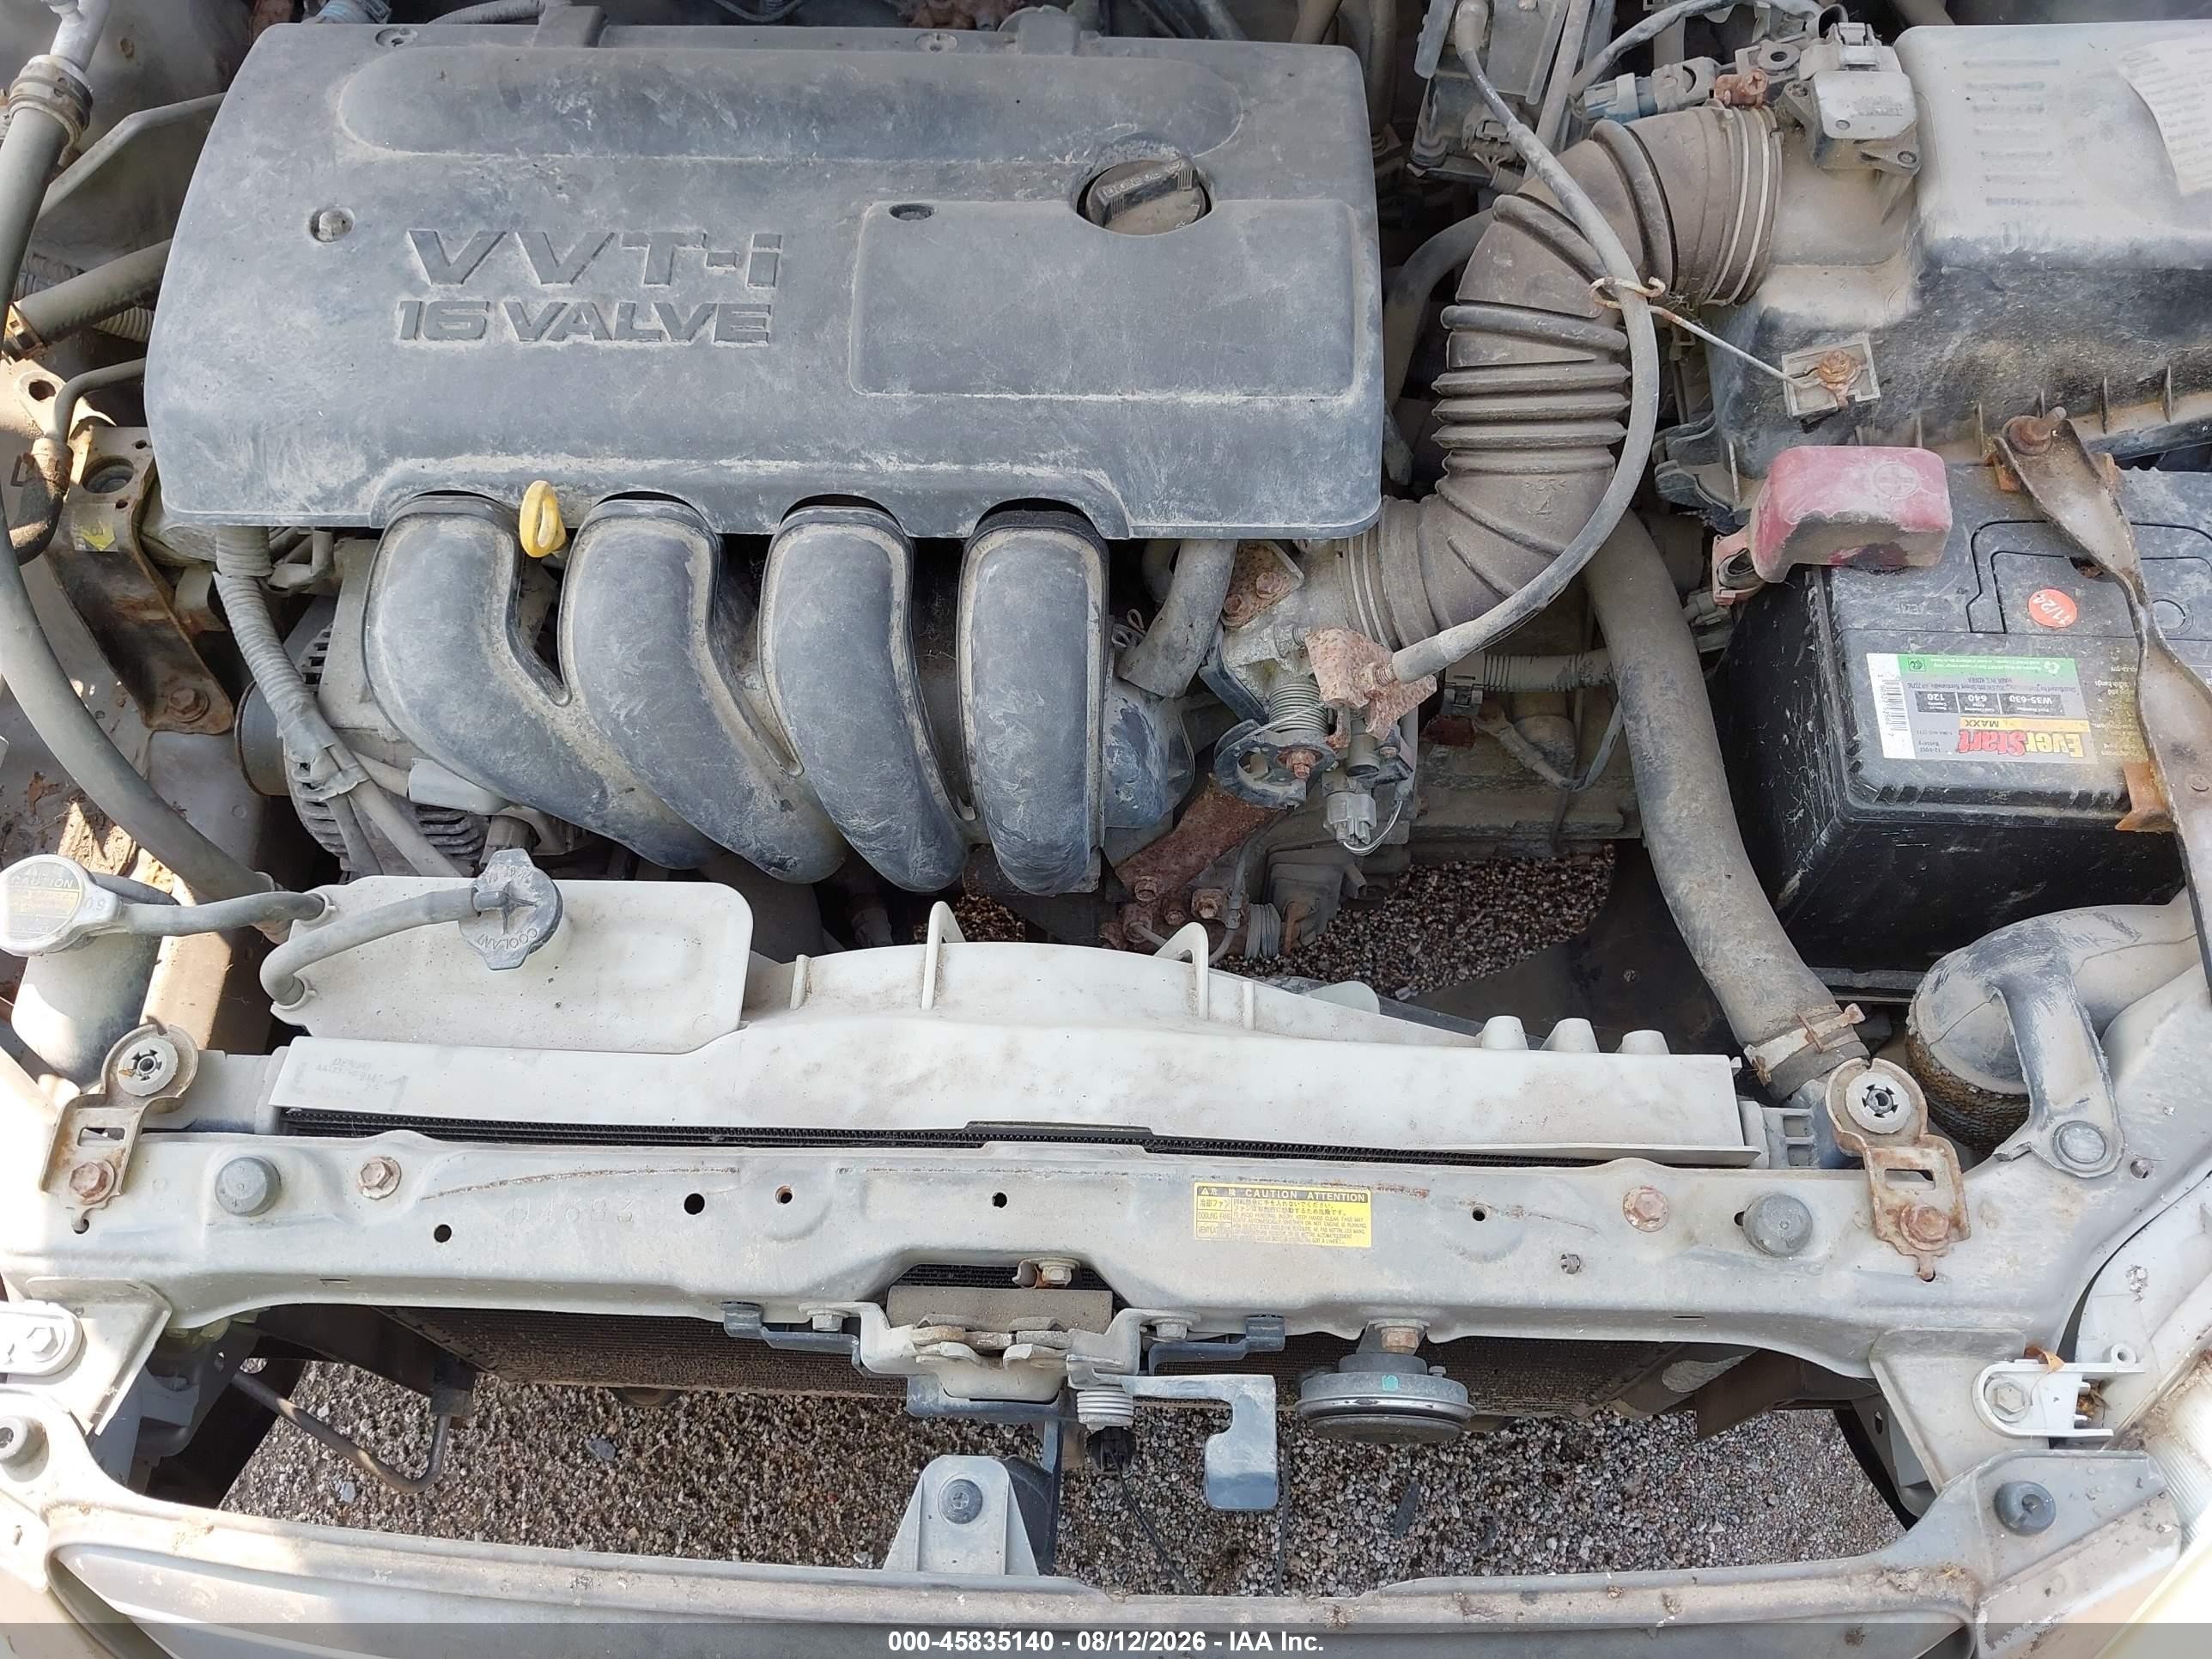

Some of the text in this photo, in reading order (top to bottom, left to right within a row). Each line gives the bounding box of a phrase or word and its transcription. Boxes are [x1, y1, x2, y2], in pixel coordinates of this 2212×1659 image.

[407, 229, 782, 288] VVT-i
[398, 301, 770, 343] 16 VALVE
[1968, 694, 1987, 702] 640
[2008, 695, 2053, 704] W35-630
[1965, 720, 1999, 728] MAXX
[1957, 730, 2084, 758] EverStart
[1245, 1190, 1365, 1202] CAUTION ATTENTION
